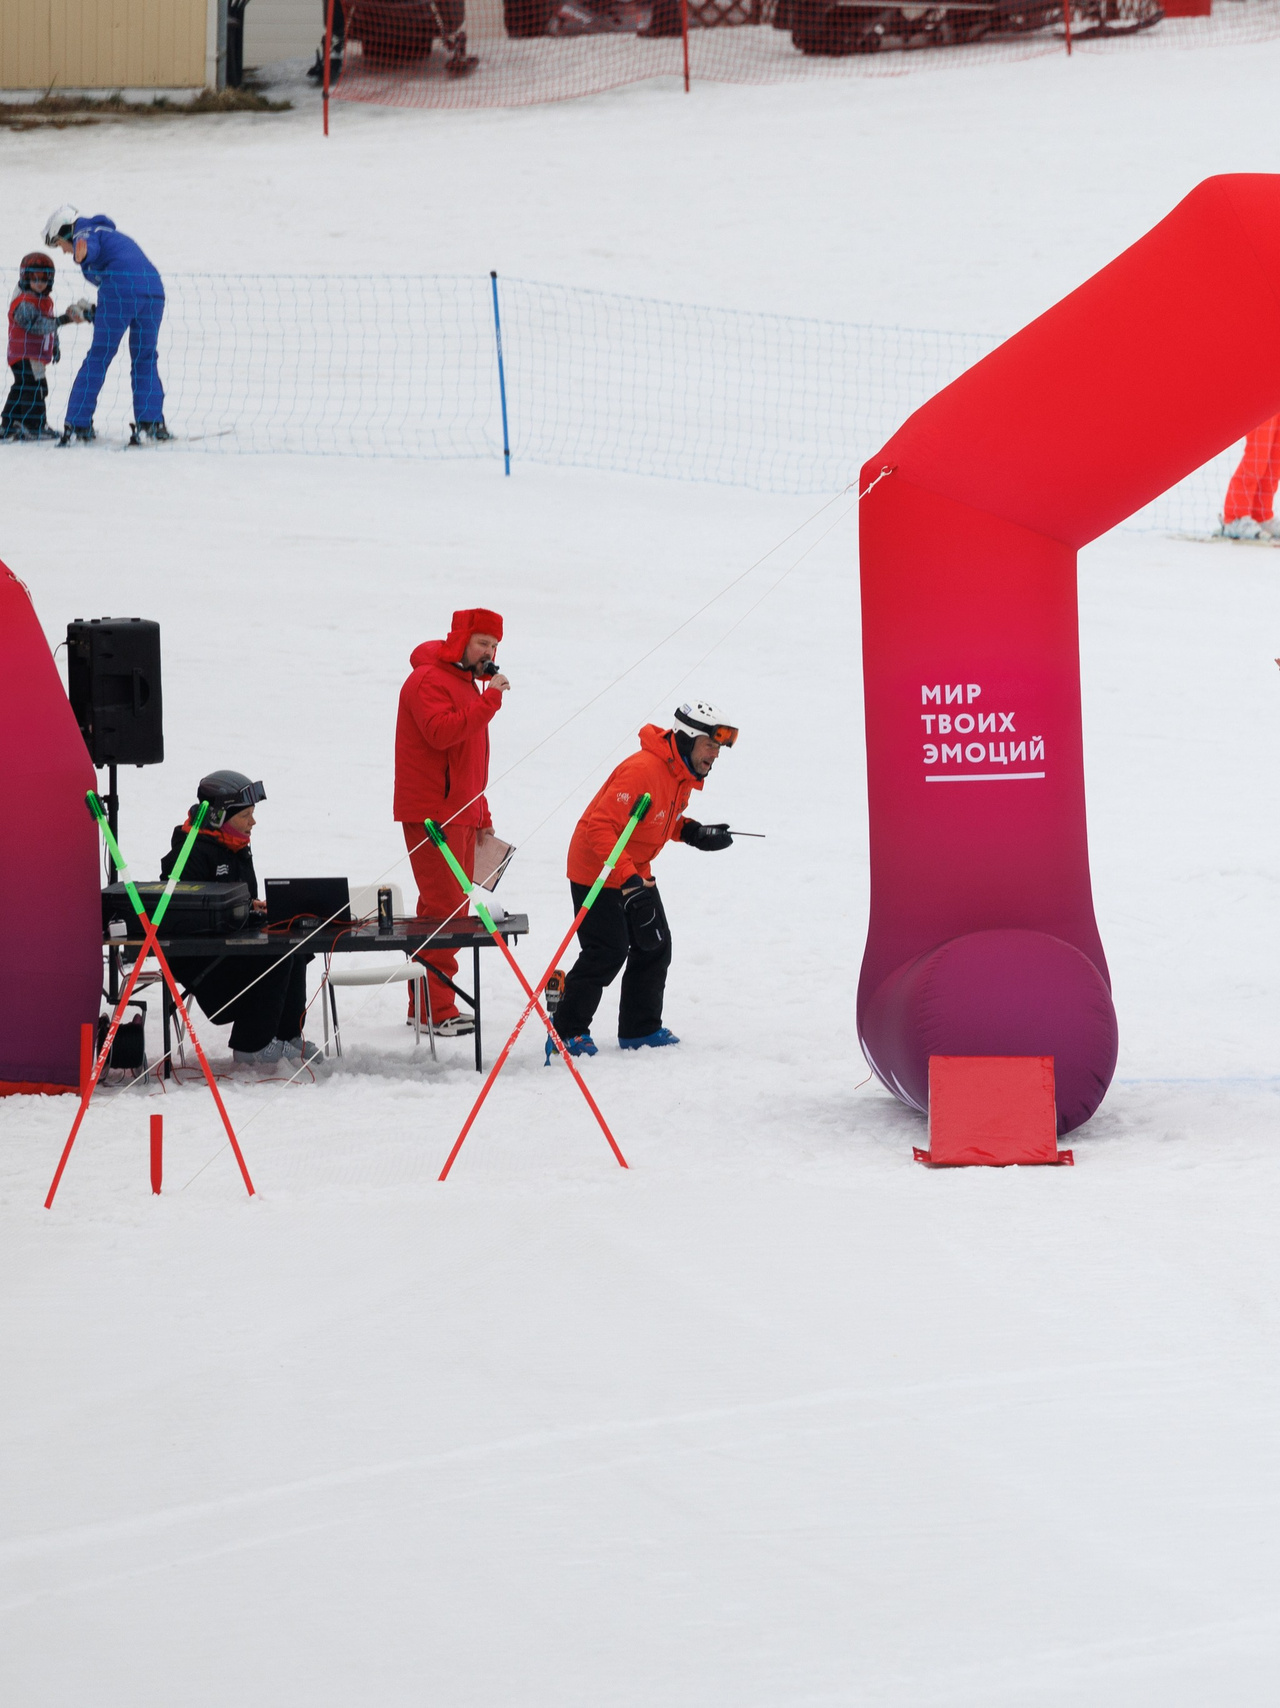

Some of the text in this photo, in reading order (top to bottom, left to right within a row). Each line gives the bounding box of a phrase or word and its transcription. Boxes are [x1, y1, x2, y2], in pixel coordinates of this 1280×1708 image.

[921, 683, 982, 705] МИР
[920, 712, 1016, 735] ТВОИХ
[922, 735, 1045, 765] ЭМОЦИЙ
